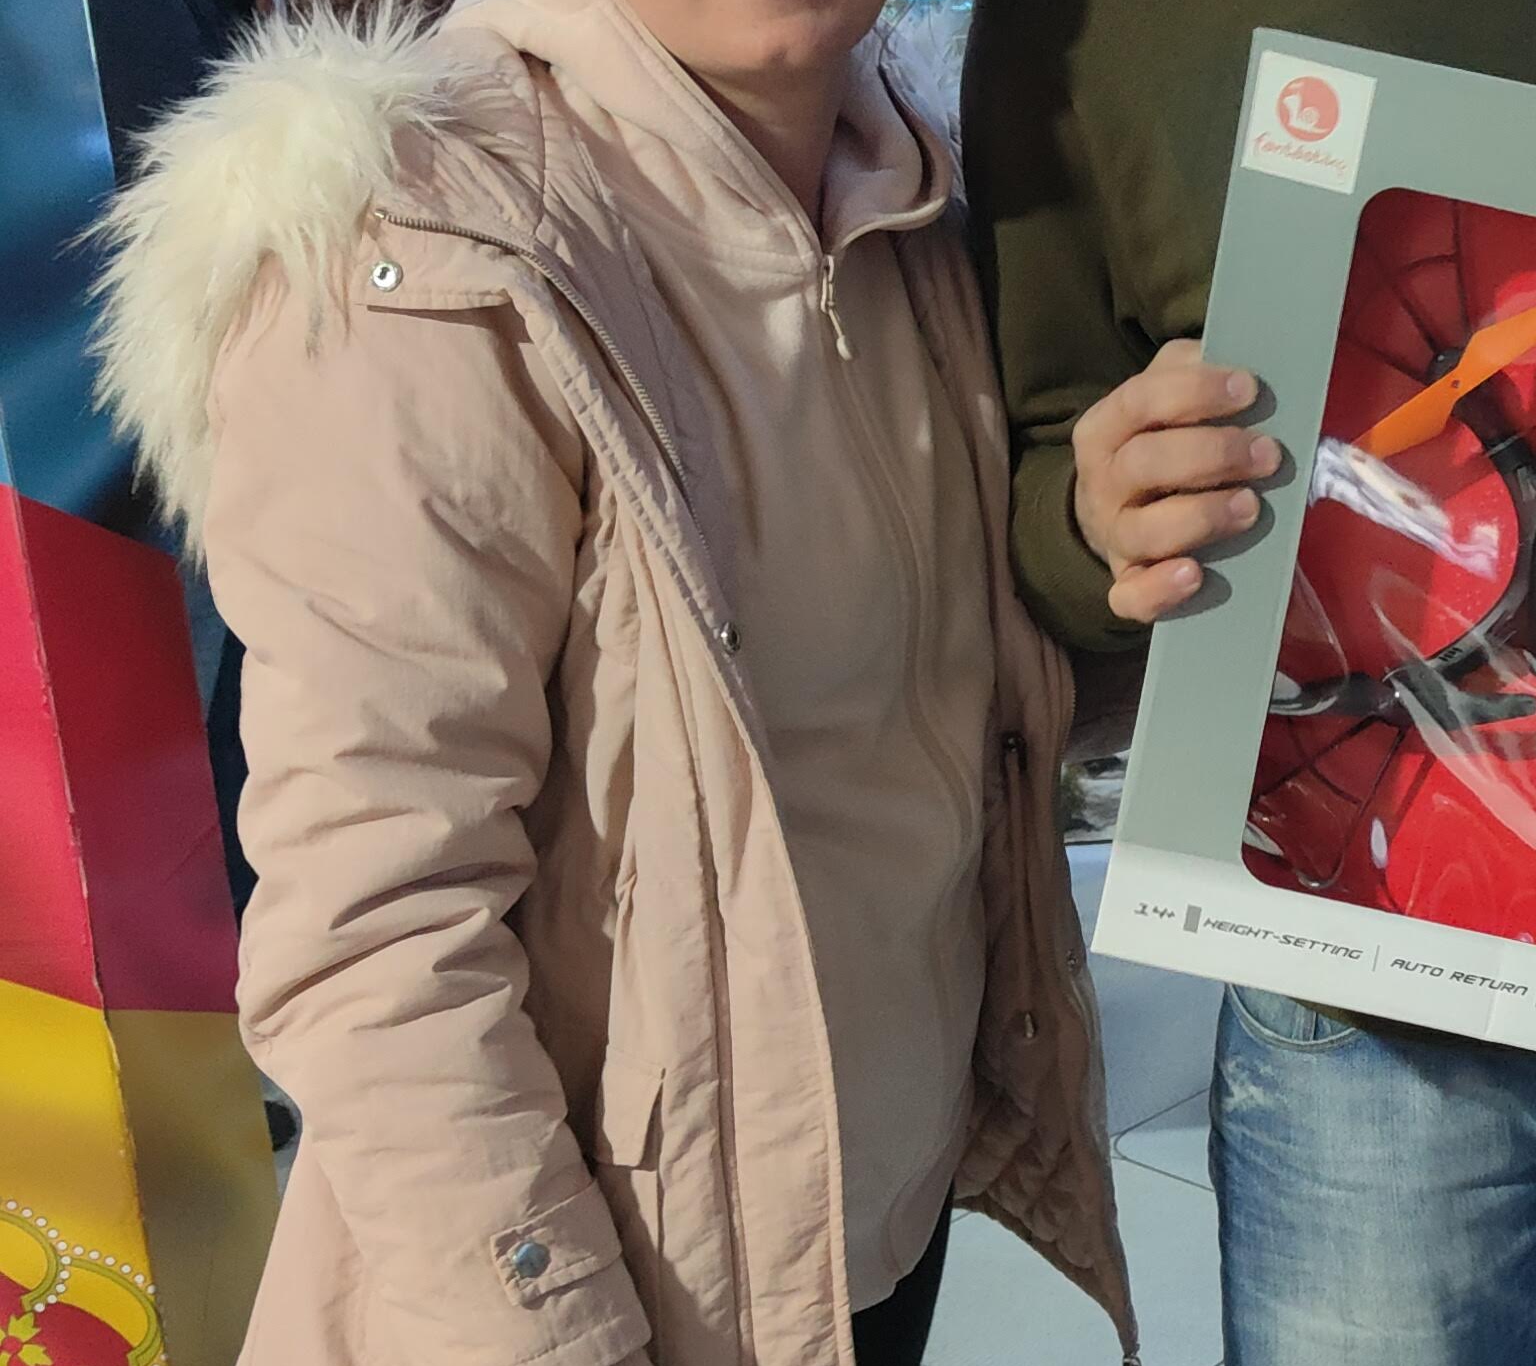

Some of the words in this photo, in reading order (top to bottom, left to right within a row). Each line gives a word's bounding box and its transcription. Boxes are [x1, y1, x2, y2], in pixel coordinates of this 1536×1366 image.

[1203, 917, 1364, 961] HEIGHT-SETTING
[1388, 957, 1444, 978] AUTO
[1448, 970, 1529, 997] RETURN
